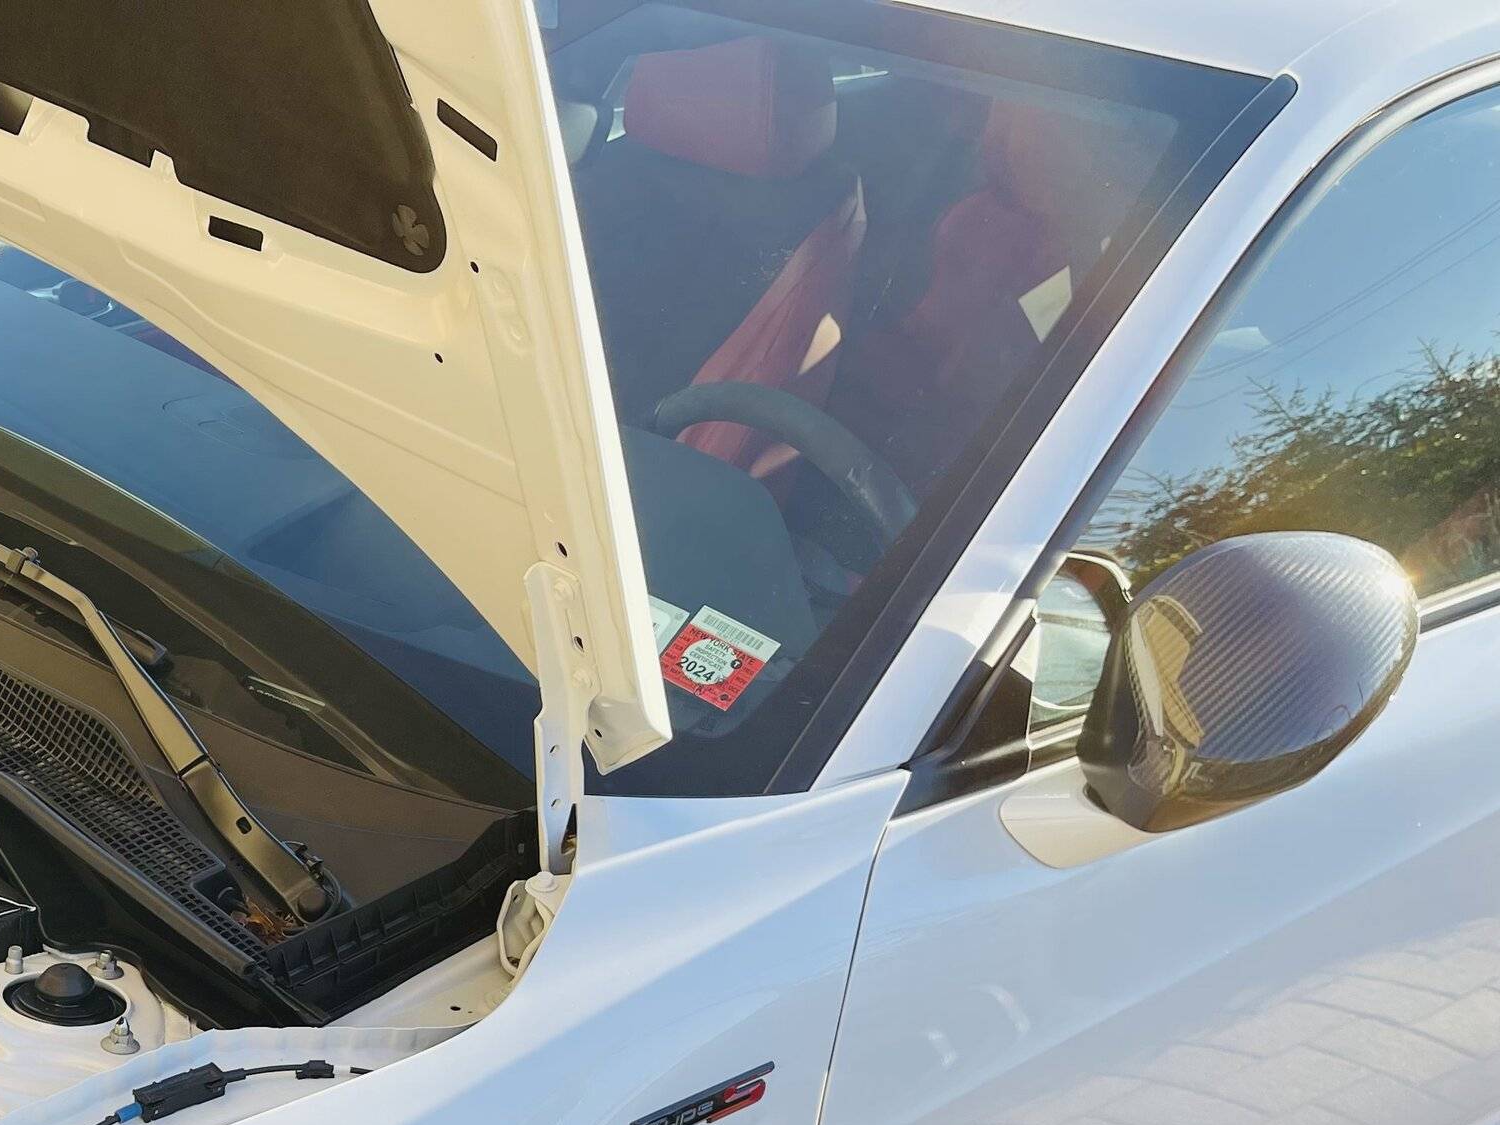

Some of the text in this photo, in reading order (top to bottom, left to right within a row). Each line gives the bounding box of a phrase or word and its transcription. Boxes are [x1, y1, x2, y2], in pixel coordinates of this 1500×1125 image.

[689, 628, 709, 640] NEW
[708, 635, 730, 653] YORK
[731, 648, 756, 666] STATE
[695, 647, 728, 666] INSPECTION
[704, 644, 726, 657] SAFETY
[676, 656, 715, 681] 2024
[689, 650, 724, 671] CERTIFICATE
